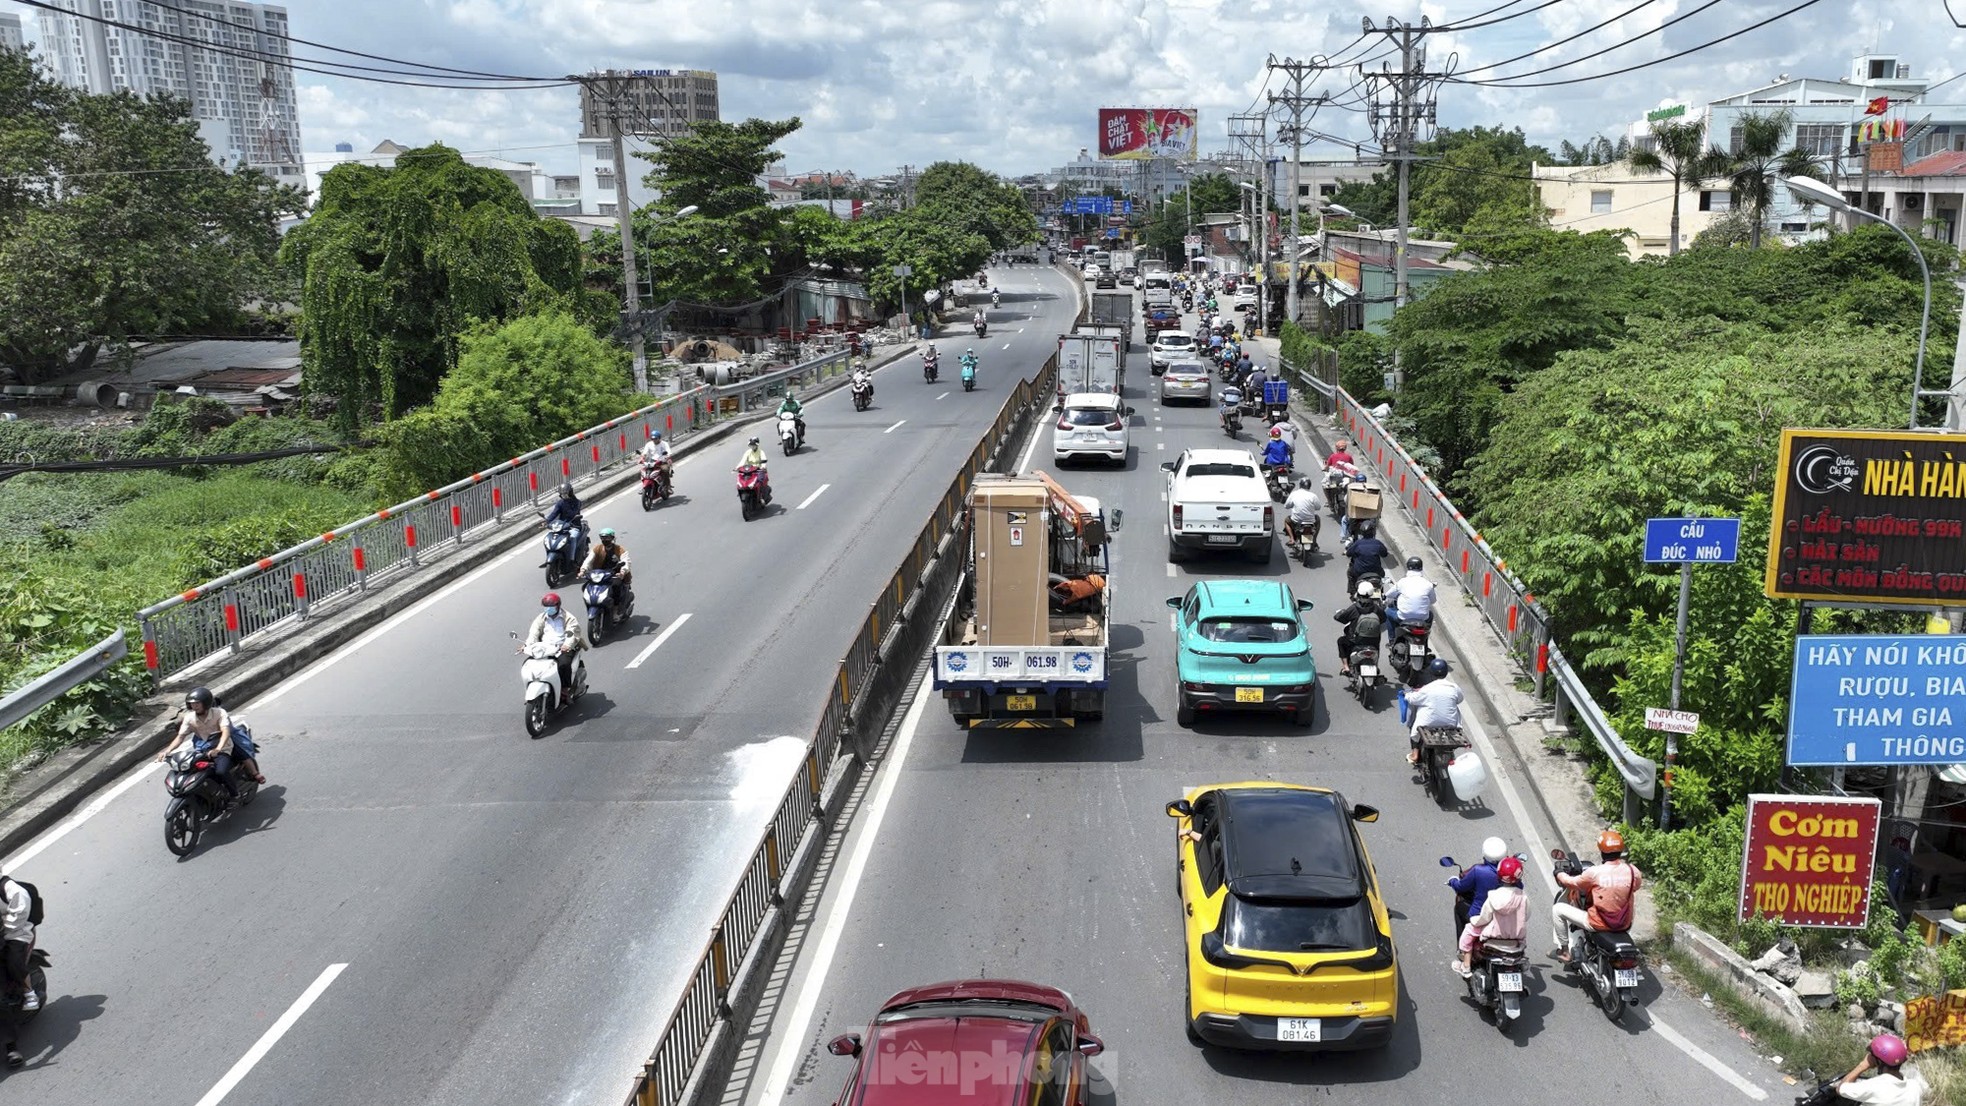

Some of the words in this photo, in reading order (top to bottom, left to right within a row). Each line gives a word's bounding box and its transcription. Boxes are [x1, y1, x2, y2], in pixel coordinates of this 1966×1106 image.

[1108, 132, 1134, 150] VIỆT
[1864, 452, 1914, 496] NHÀ
[1680, 520, 1704, 538] CẦU
[1662, 542, 1686, 560] ĐÚC
[1696, 541, 1722, 560] NHỎ
[1026, 656, 1056, 668] 061.98
[1808, 644, 1857, 666] HÃY
[1865, 642, 1908, 666] NÓI
[1926, 677, 1966, 696] BIA
[1833, 708, 1902, 726] THAM
[1912, 708, 1952, 726] GIA
[1882, 735, 1964, 756] THÔNG
[1769, 810, 1858, 838] Cơm
[1762, 844, 1856, 872] Niêu
[1793, 876, 1862, 922] NGHIỆP
[1290, 1020, 1308, 1030] 61K
[1282, 1030, 1316, 1040] 081.46
